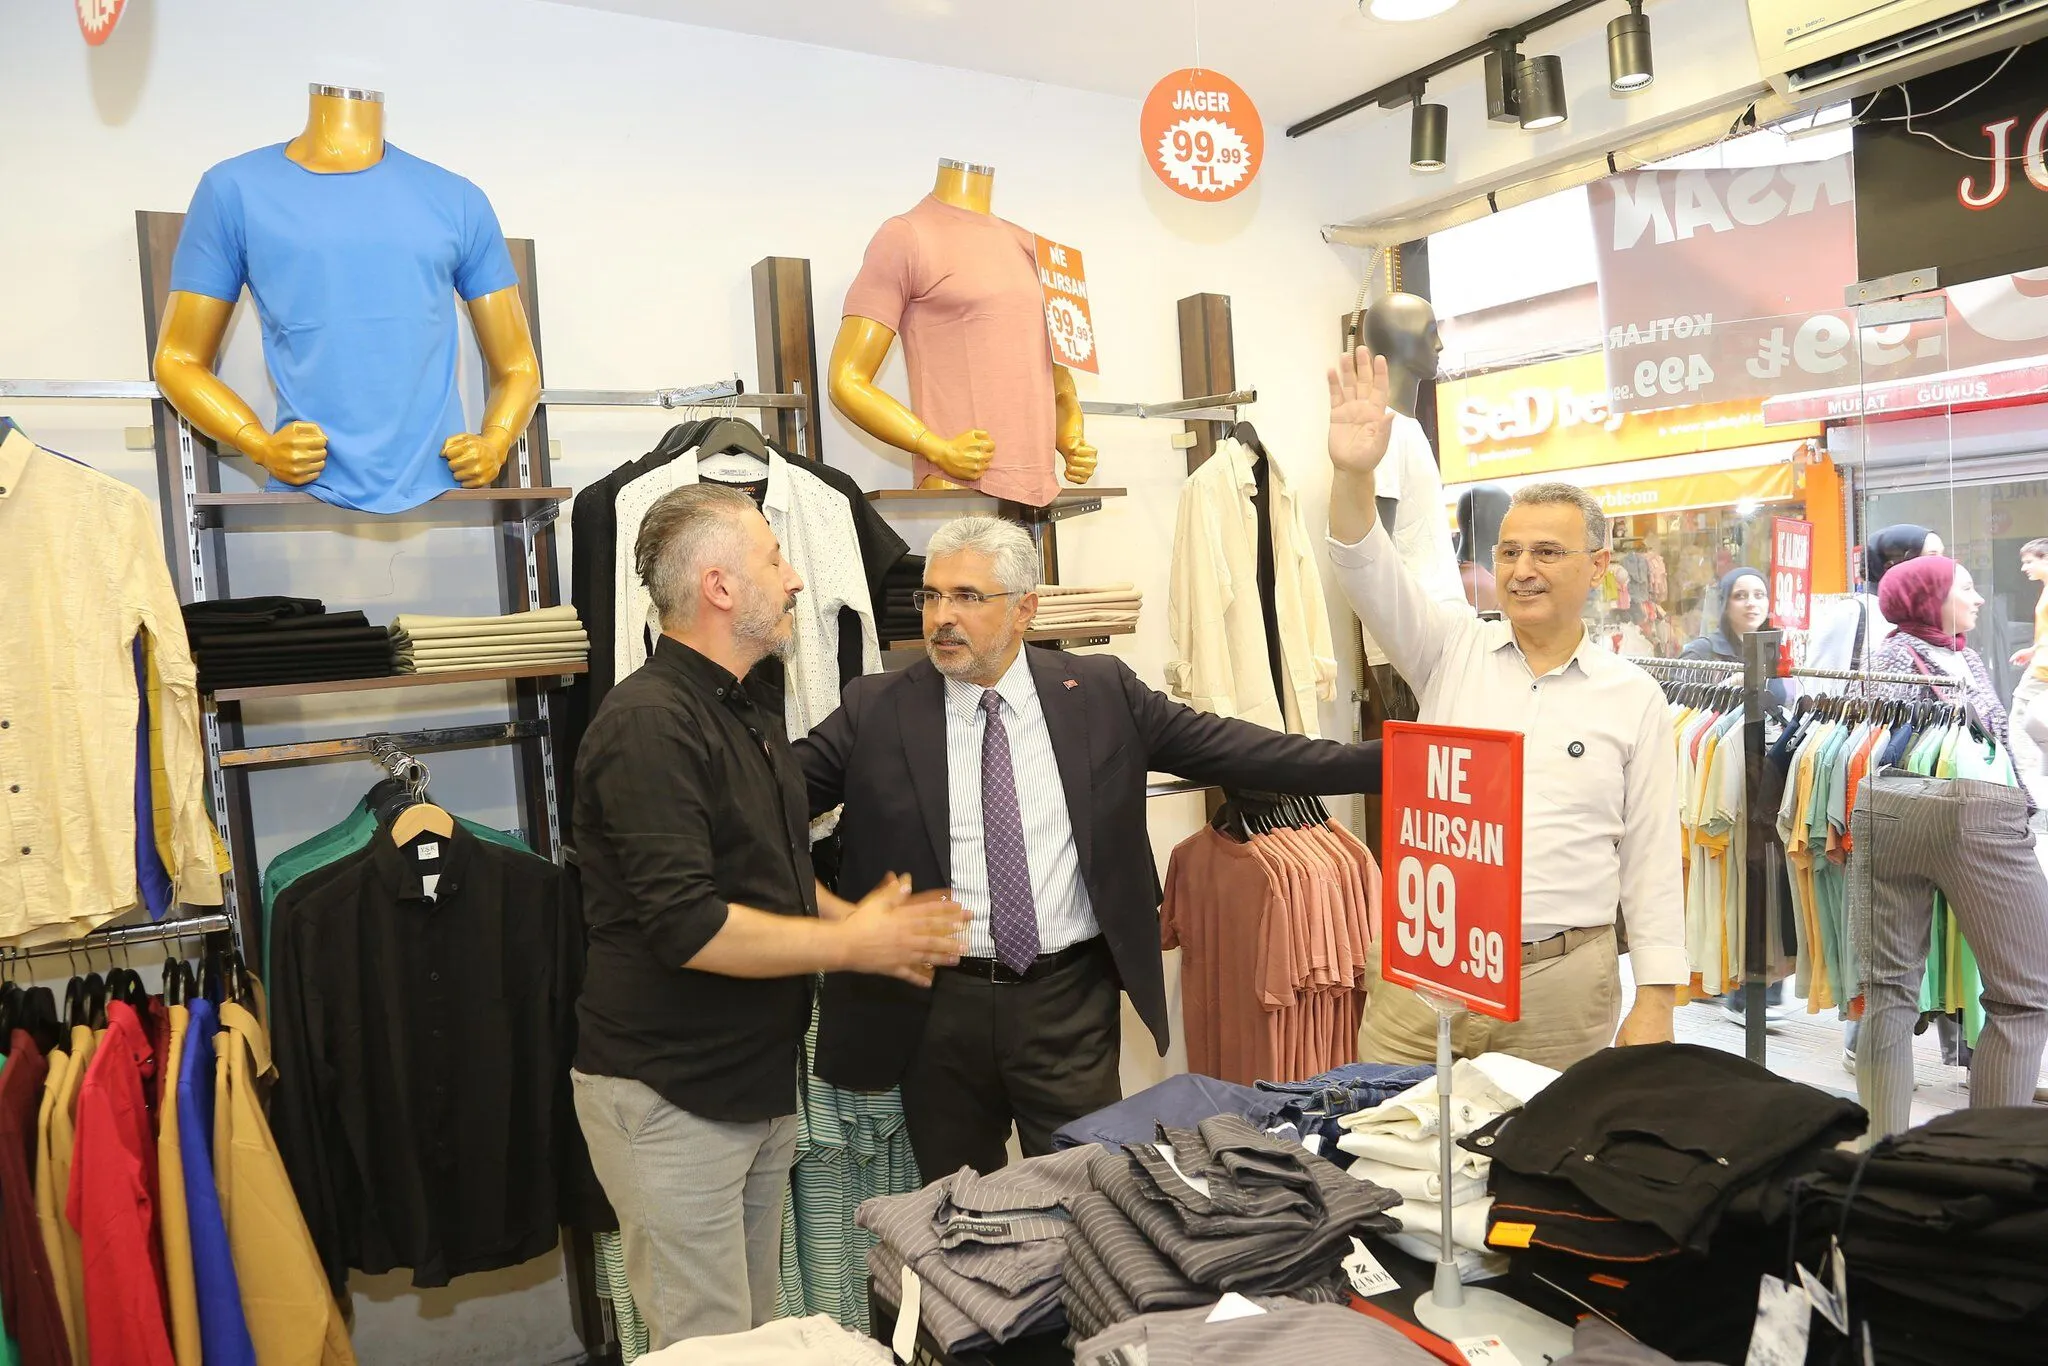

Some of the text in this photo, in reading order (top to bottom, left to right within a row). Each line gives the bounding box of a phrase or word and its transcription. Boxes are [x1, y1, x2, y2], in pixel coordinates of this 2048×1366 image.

[1172, 89, 1230, 112] JAGER
[1191, 165, 1222, 185] TL
[1048, 246, 1068, 268] NE
[1041, 266, 1088, 300] ALIRSAN
[1065, 337, 1082, 357] TL
[1827, 394, 1888, 415] MURAT
[1426, 744, 1473, 805] NE
[1399, 807, 1504, 867] ALIRSAN
